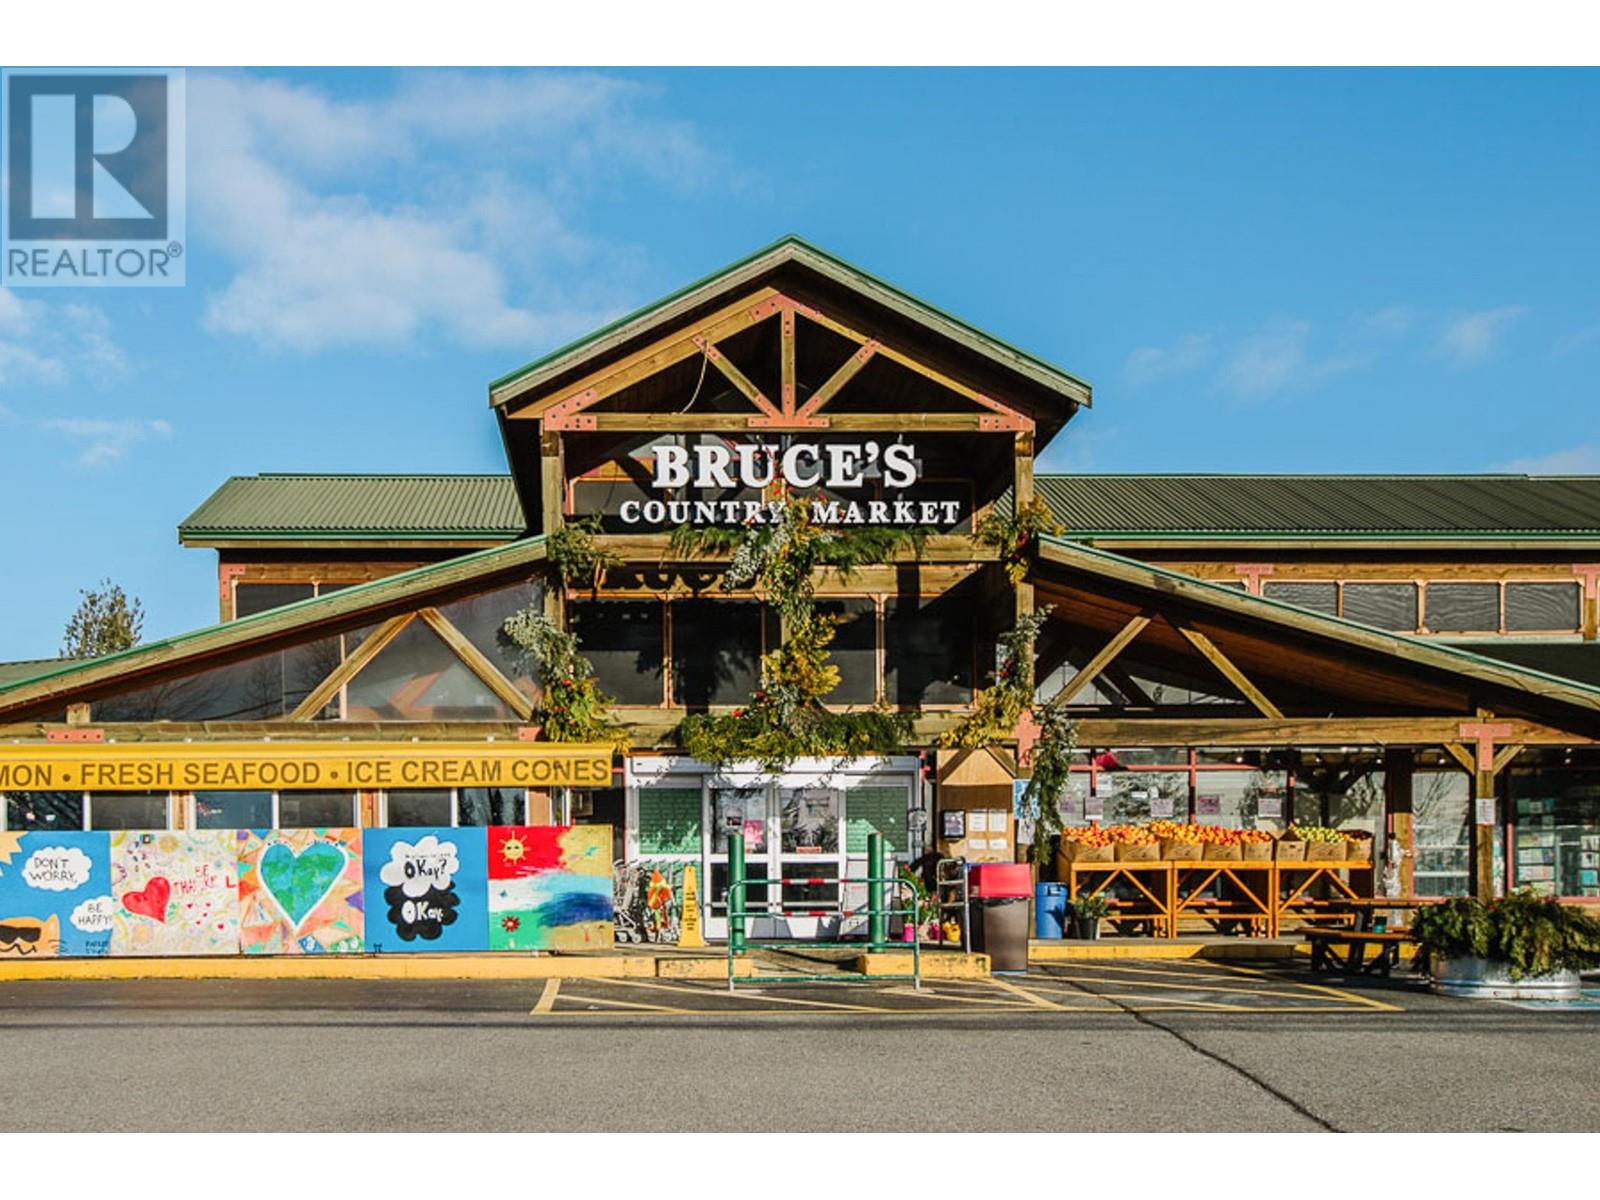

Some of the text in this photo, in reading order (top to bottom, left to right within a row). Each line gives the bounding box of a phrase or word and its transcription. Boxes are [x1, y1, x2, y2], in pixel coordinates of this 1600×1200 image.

[652, 441, 919, 489] BRUCE'S
[619, 500, 960, 524] COUNTRY MARKET
[81, 763, 174, 786] FRESH
[183, 762, 321, 785] SEAFOOD
[347, 761, 391, 783] ICE
[401, 760, 501, 783] CREAM
[511, 759, 609, 781] CONES
